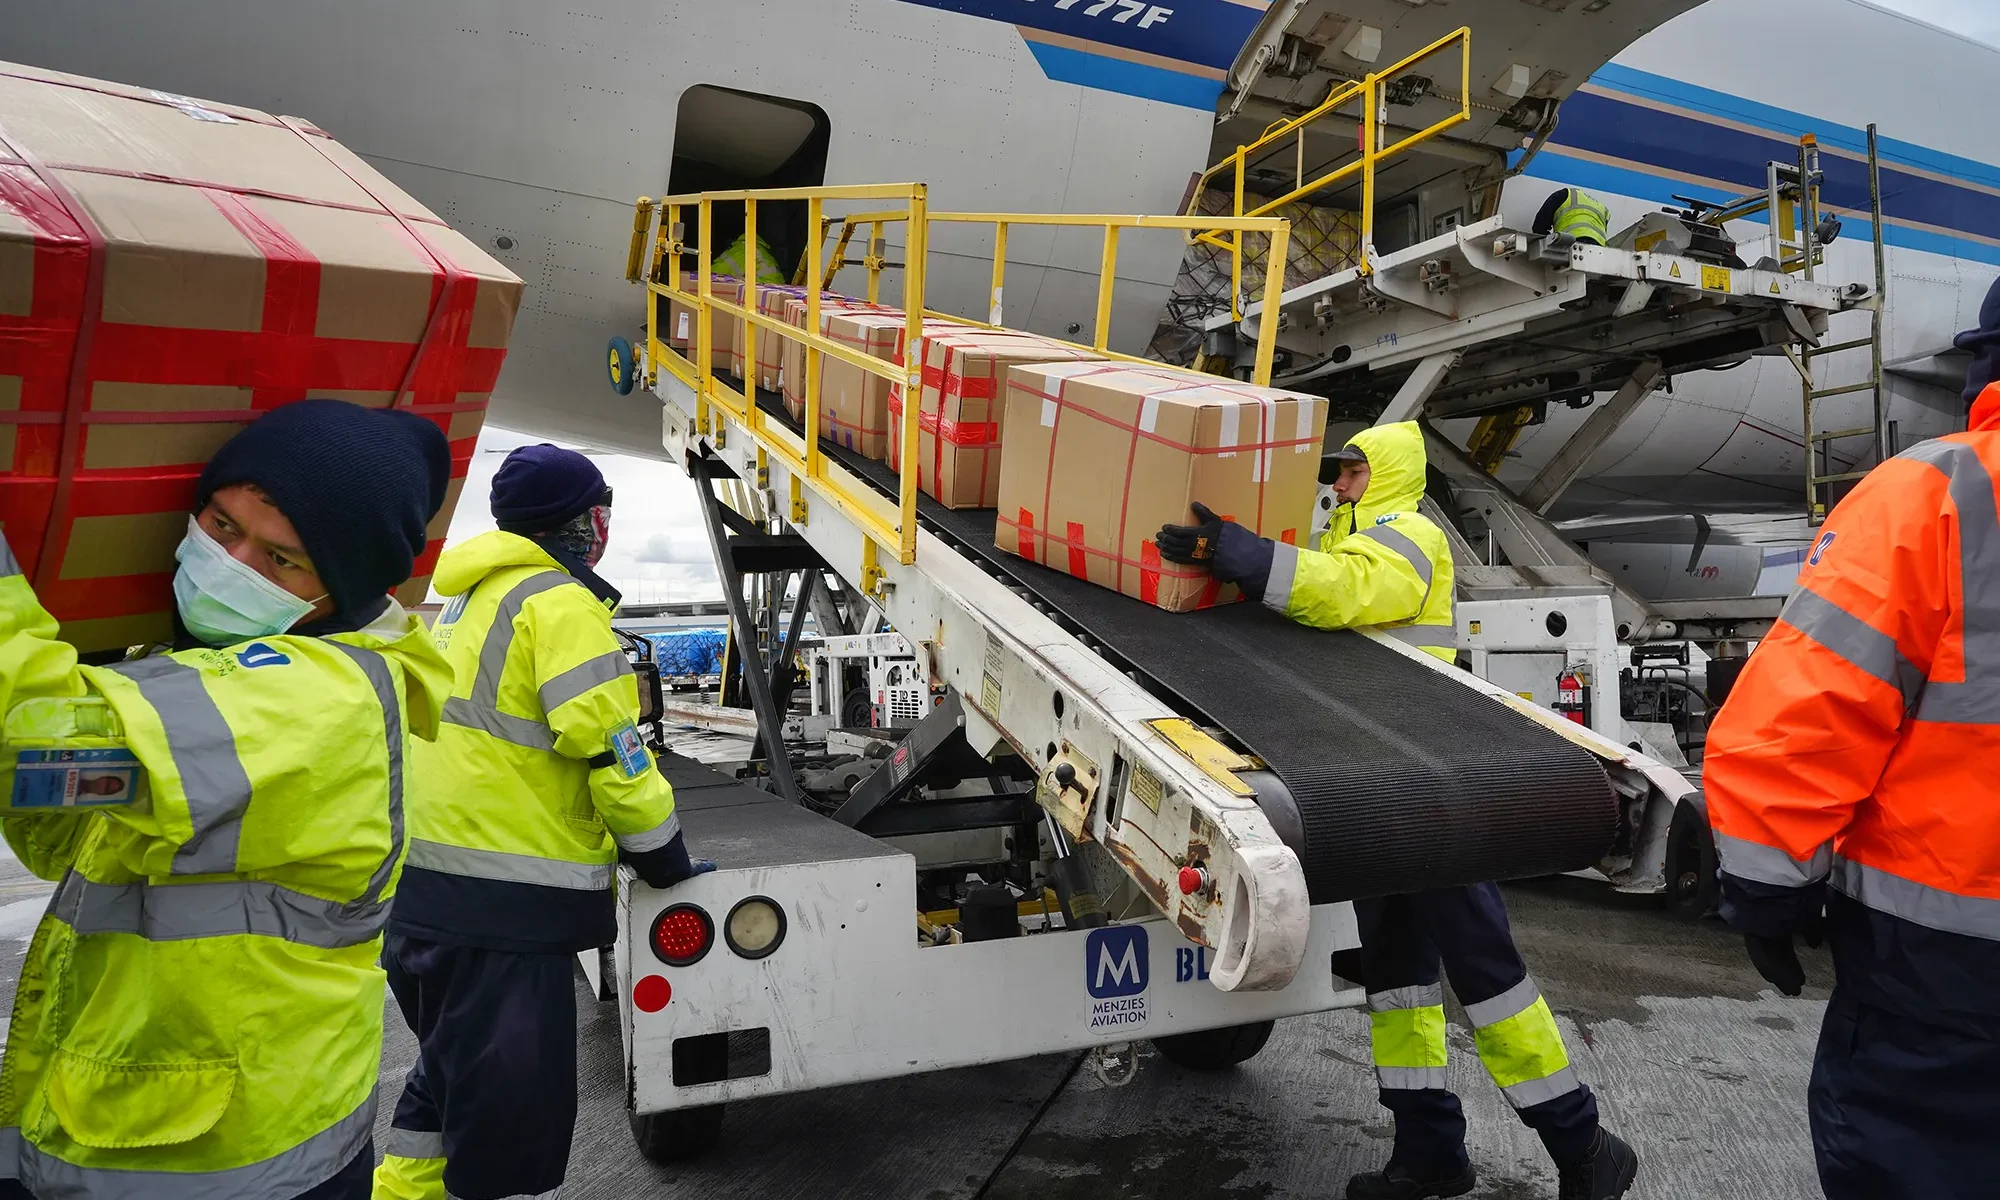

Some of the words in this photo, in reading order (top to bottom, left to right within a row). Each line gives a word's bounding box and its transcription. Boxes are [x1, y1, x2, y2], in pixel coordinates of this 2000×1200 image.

[1095, 938, 1141, 988] M
[1093, 997, 1145, 1015] MENZIES
[1091, 1011, 1147, 1028] AVIATION
